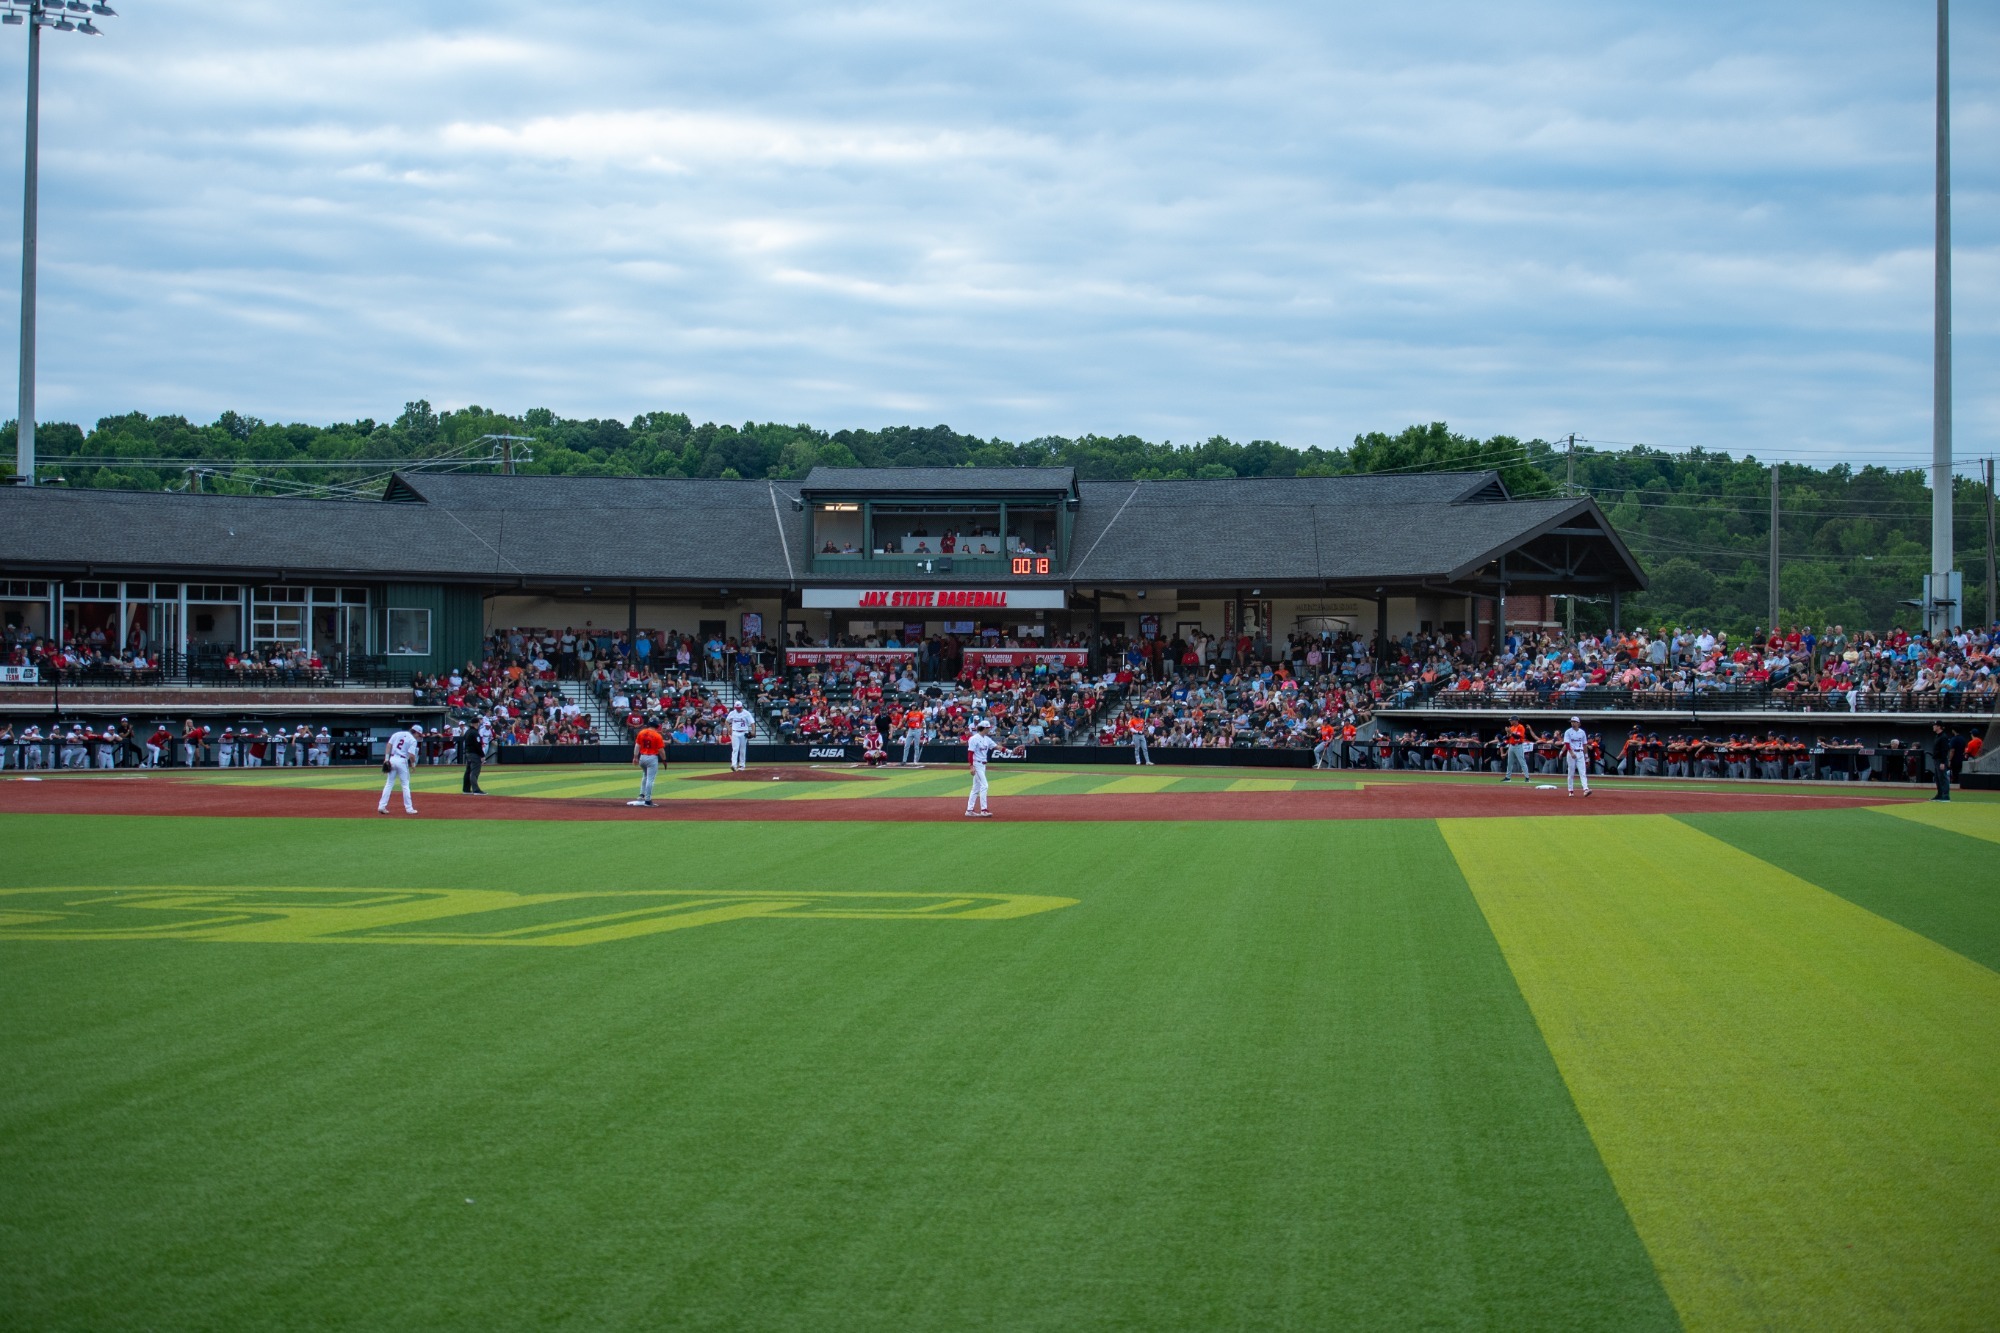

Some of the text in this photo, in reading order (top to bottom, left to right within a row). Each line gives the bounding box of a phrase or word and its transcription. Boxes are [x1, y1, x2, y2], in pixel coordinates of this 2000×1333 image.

[859, 591, 1007, 607] JAX STATE BASEBALL
[396, 739, 404, 750] 2
